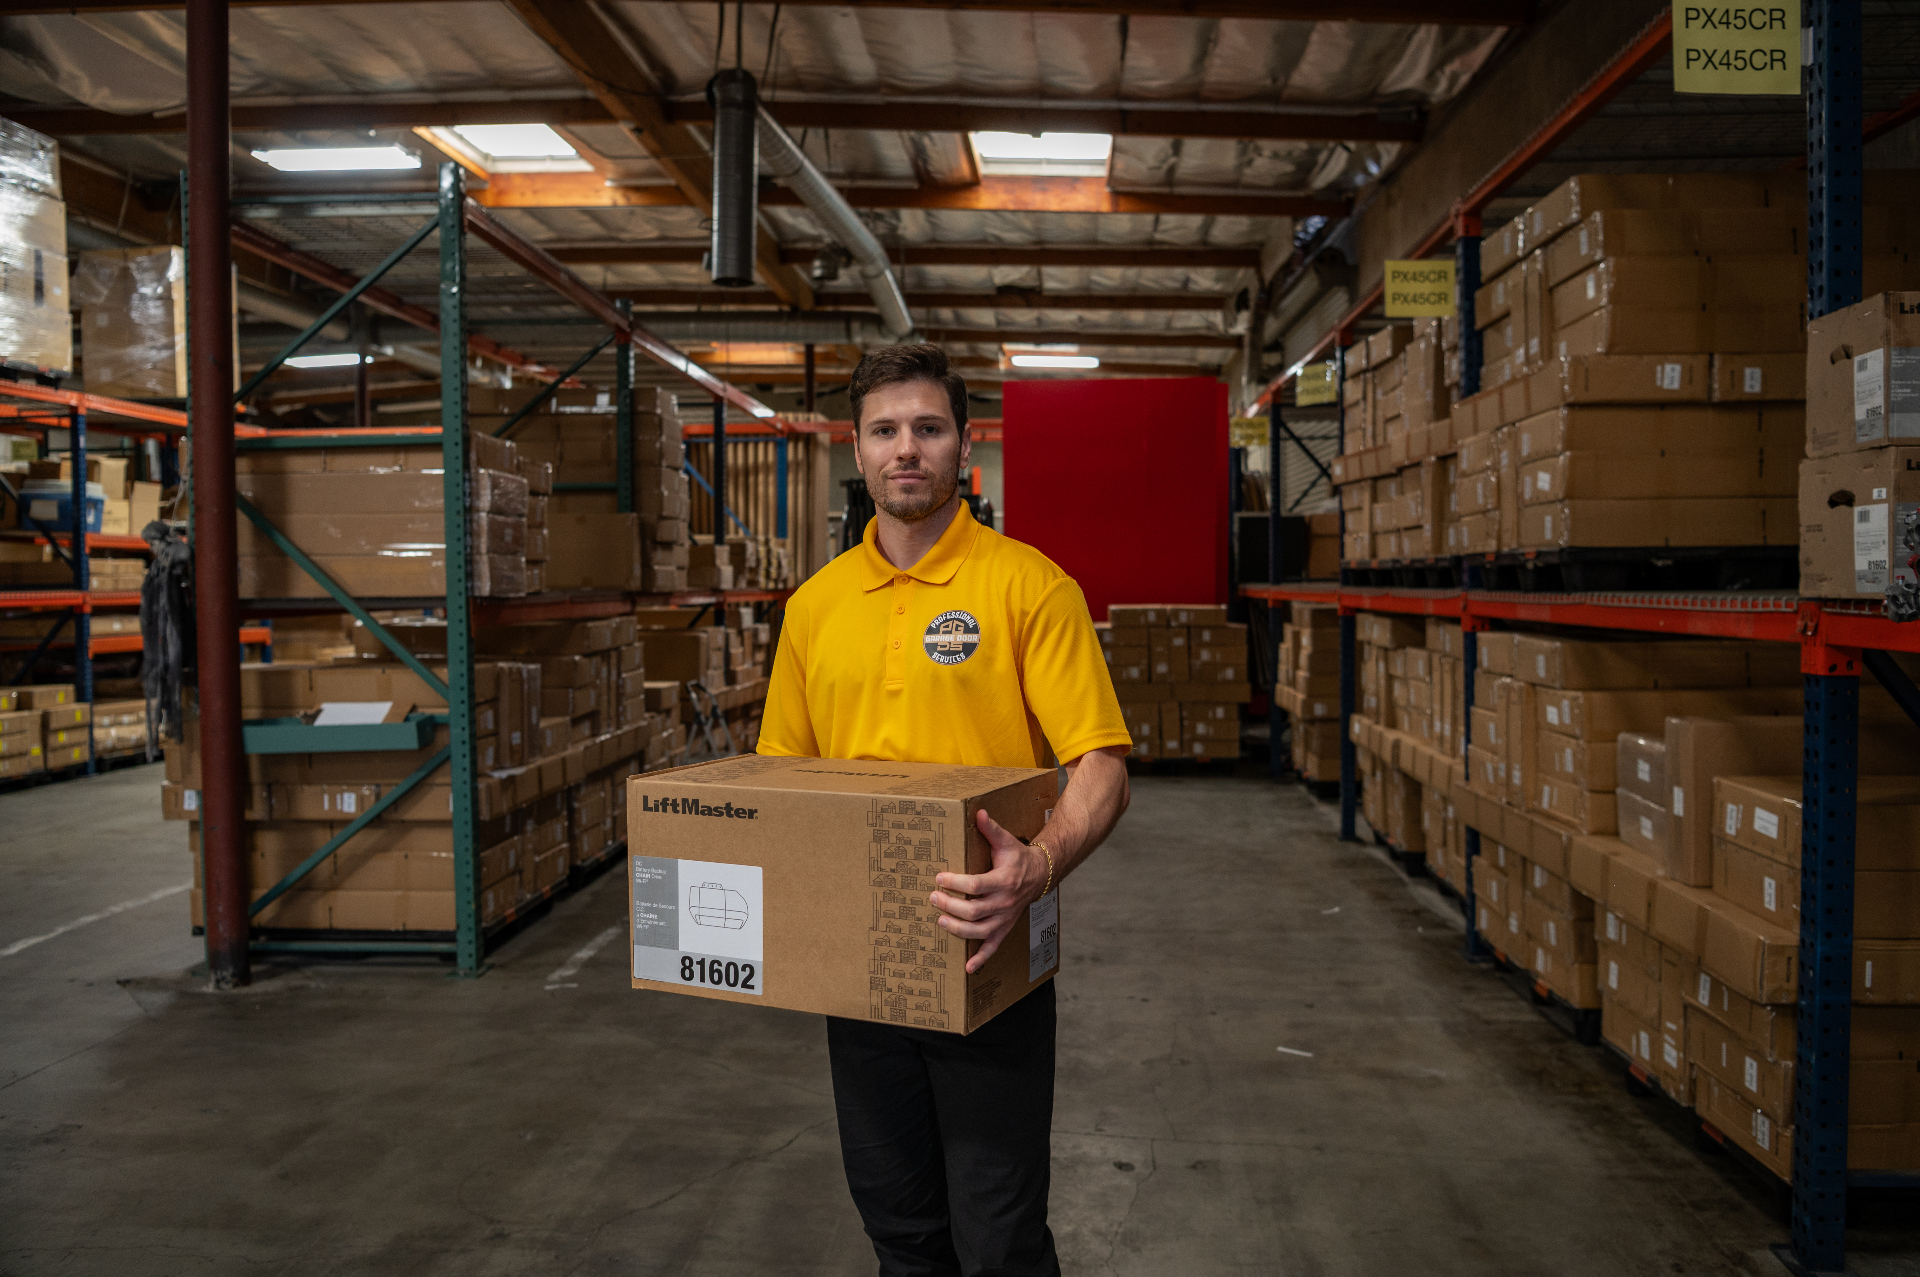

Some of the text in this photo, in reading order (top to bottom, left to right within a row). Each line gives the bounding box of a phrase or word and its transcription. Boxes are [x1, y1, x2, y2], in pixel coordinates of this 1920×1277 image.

[1685, 7, 1786, 30] PX45CR
[1686, 48, 1787, 71] PX45CR
[1391, 270, 1449, 283] PX45CR
[1391, 292, 1449, 305] PX45CR
[931, 612, 976, 628] PROFESSIONAL
[932, 652, 966, 664] SERVICES
[642, 795, 758, 820] LiftMaster
[680, 955, 755, 990] 81602
